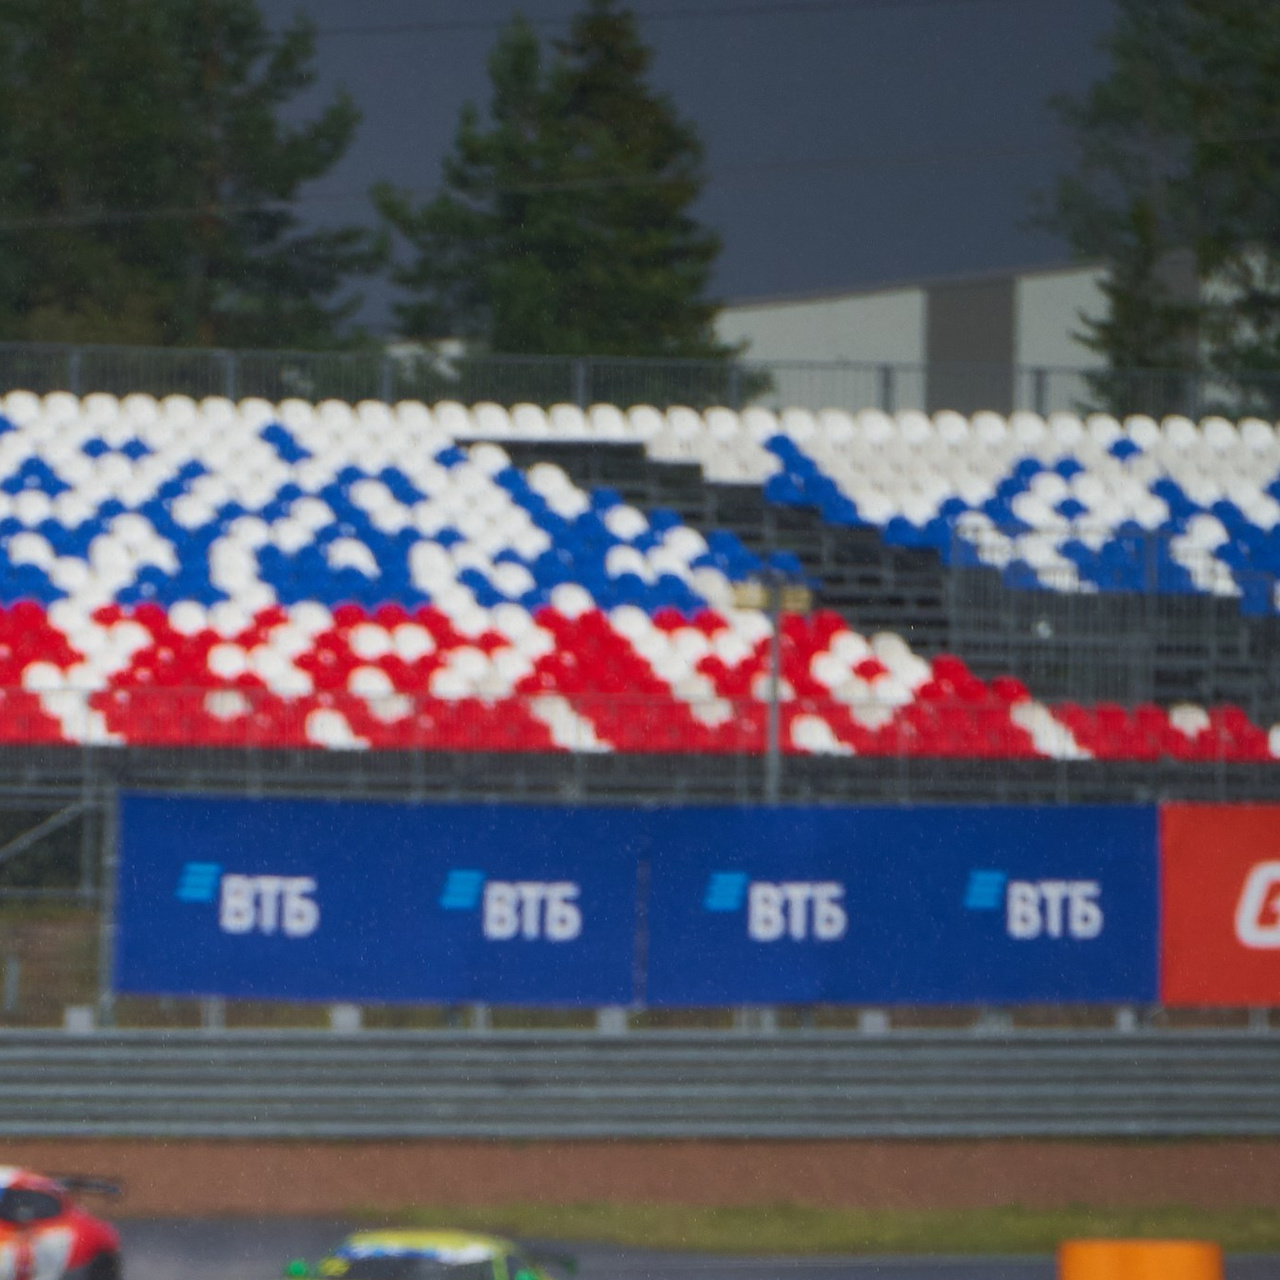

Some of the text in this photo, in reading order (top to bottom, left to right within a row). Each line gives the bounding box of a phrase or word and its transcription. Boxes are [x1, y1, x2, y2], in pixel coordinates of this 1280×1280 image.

[222, 874, 320, 938] ВТБ
[483, 880, 581, 941] ВТБ
[748, 880, 848, 942] ВТБ
[1007, 879, 1104, 940] ВТБ
